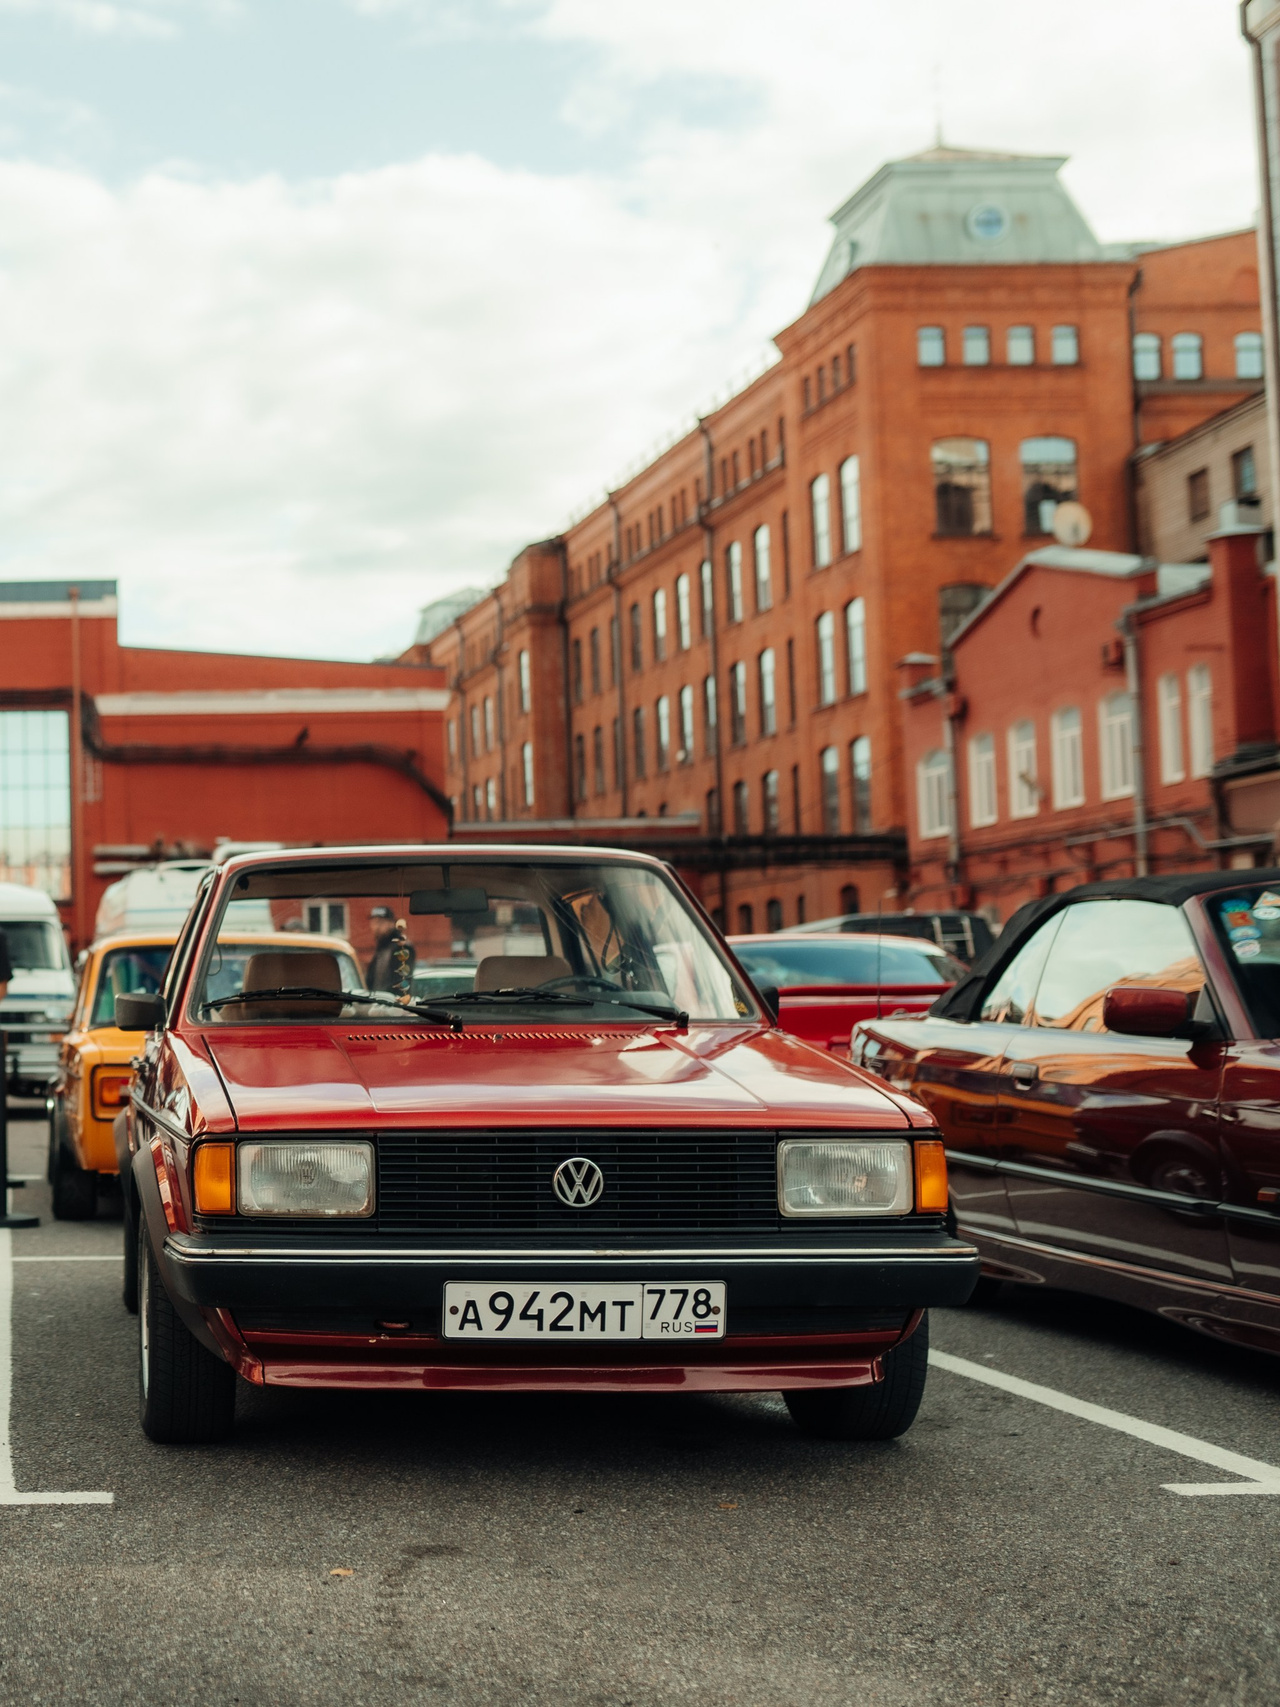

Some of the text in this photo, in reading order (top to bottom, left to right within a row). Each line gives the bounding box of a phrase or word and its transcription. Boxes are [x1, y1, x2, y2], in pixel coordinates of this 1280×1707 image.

[555, 1159, 602, 1205] VW
[647, 1288, 712, 1320] 778
[660, 1322, 693, 1333] RUS
